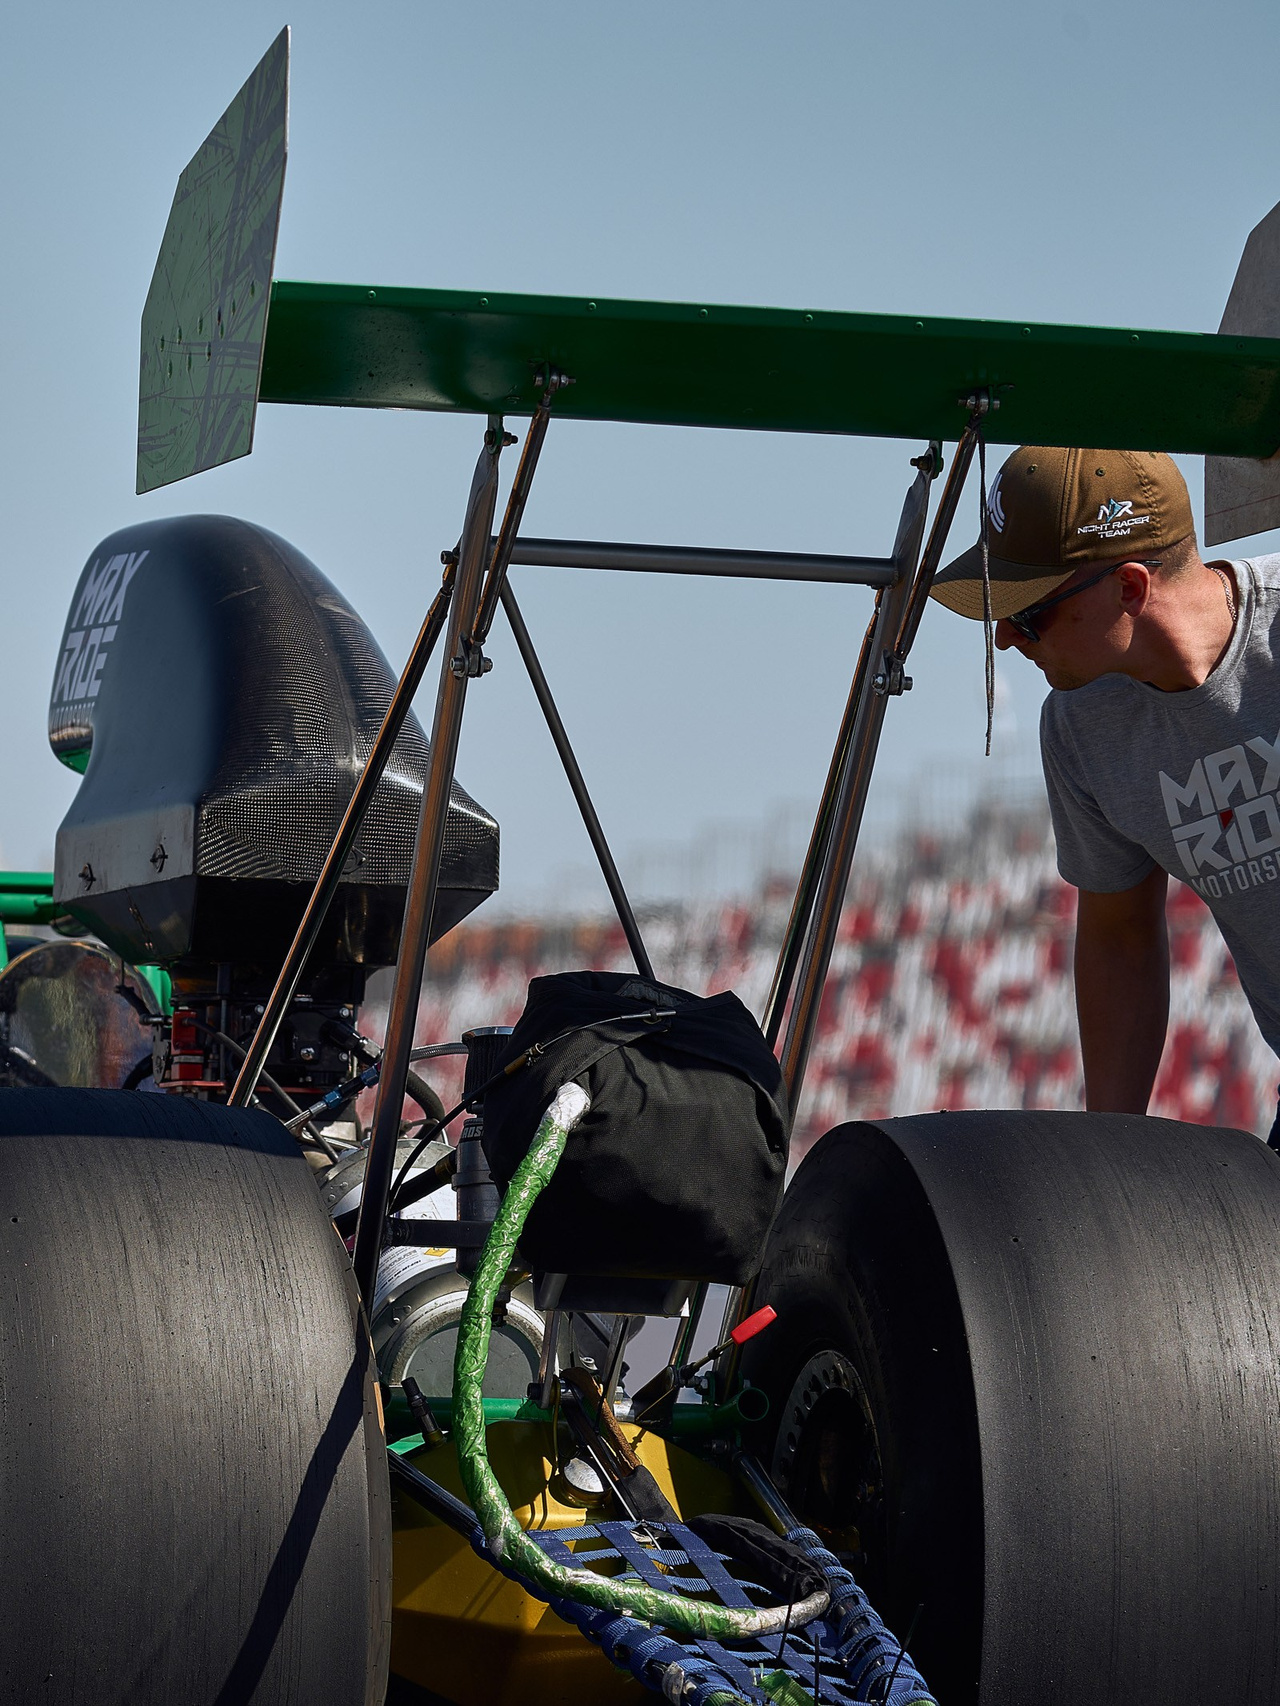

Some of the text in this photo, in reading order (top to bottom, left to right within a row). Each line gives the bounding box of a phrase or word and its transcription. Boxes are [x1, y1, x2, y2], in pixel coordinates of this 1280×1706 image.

[1077, 515, 1150, 535] NIGHT RACER
[1098, 528, 1131, 539] TEAM
[71, 550, 151, 629] MAX
